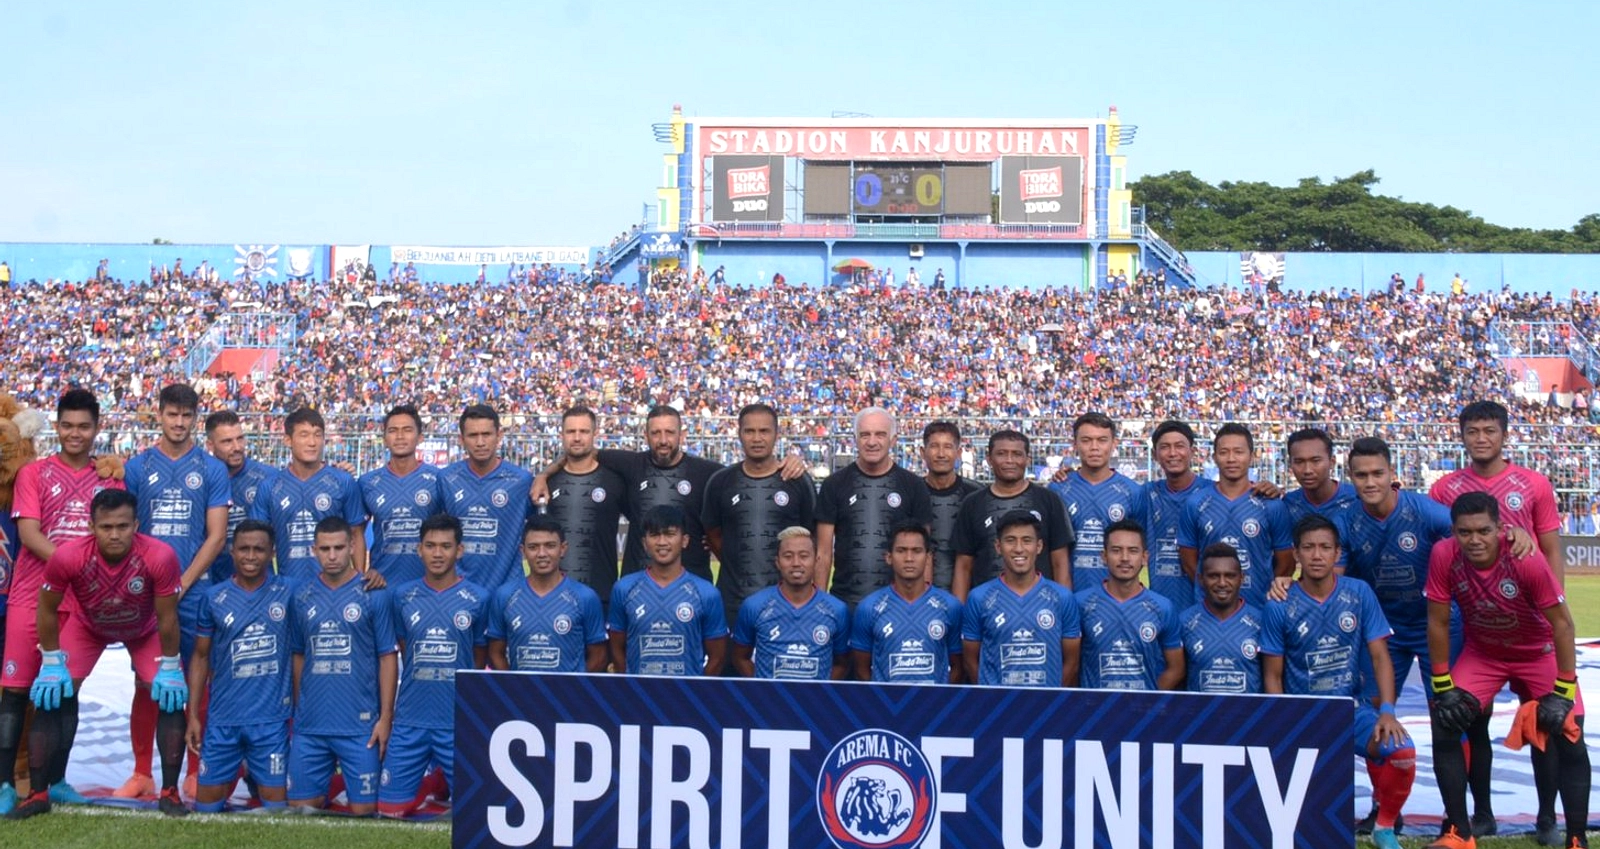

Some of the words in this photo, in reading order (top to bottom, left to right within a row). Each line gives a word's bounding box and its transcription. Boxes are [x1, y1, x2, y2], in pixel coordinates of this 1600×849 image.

[709, 130, 847, 153] STADION
[869, 130, 1079, 153] KANJURUHAN
[731, 171, 766, 183] TORA
[1022, 172, 1059, 184] TORA
[733, 182, 767, 194] BIKA
[855, 173, 883, 207] 0
[915, 173, 941, 207] 0
[1025, 183, 1059, 195] BIKA
[732, 199, 768, 213] DUO
[1024, 200, 1061, 213] DUO
[837, 734, 891, 768] AREMA
[894, 739, 912, 768] FC
[487, 719, 811, 849] SPIRIT
[1002, 737, 1319, 849] UNITY
